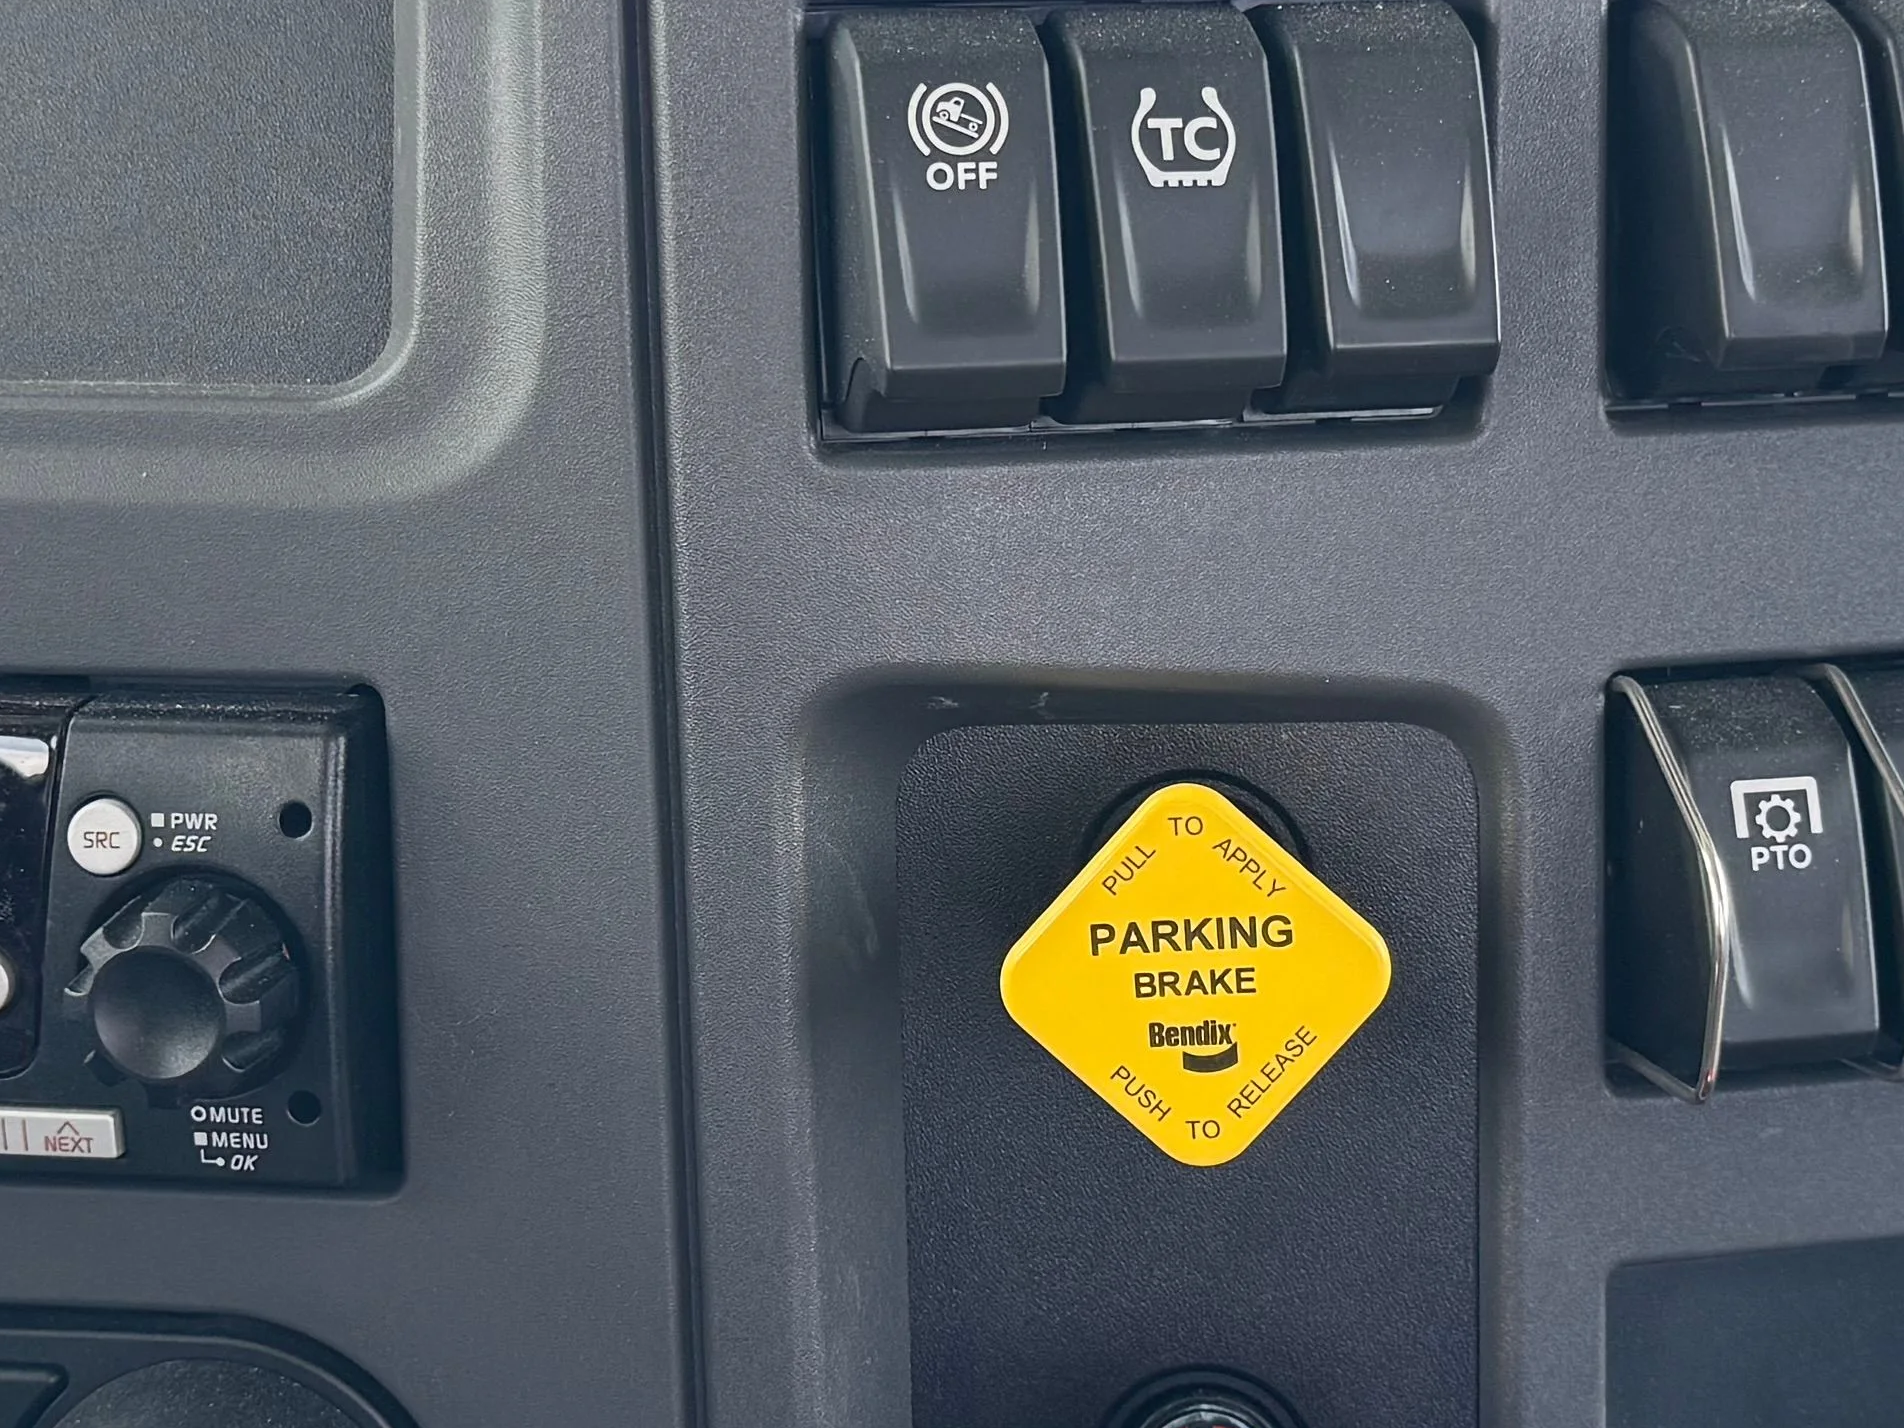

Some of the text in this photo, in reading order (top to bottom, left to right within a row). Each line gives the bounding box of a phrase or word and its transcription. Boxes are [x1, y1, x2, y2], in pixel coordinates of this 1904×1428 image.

[1146, 117, 1222, 162] TC
[925, 161, 999, 191] OFF
[170, 812, 219, 831] PWR
[83, 831, 121, 850] SRC
[170, 835, 213, 853] ESC
[1100, 815, 1288, 898] PULL TO APPLY
[1750, 843, 1813, 871] PTO
[1089, 914, 1295, 957] PARKING
[1133, 967, 1258, 999] BRAKE
[1147, 1020, 1234, 1048] Bendix
[1109, 1024, 1319, 1141] PUSH TO RELEASE
[208, 1106, 264, 1124] MUTE
[44, 1135, 95, 1155] NEXT
[211, 1131, 269, 1150] MENU
[230, 1154, 259, 1172] OK
